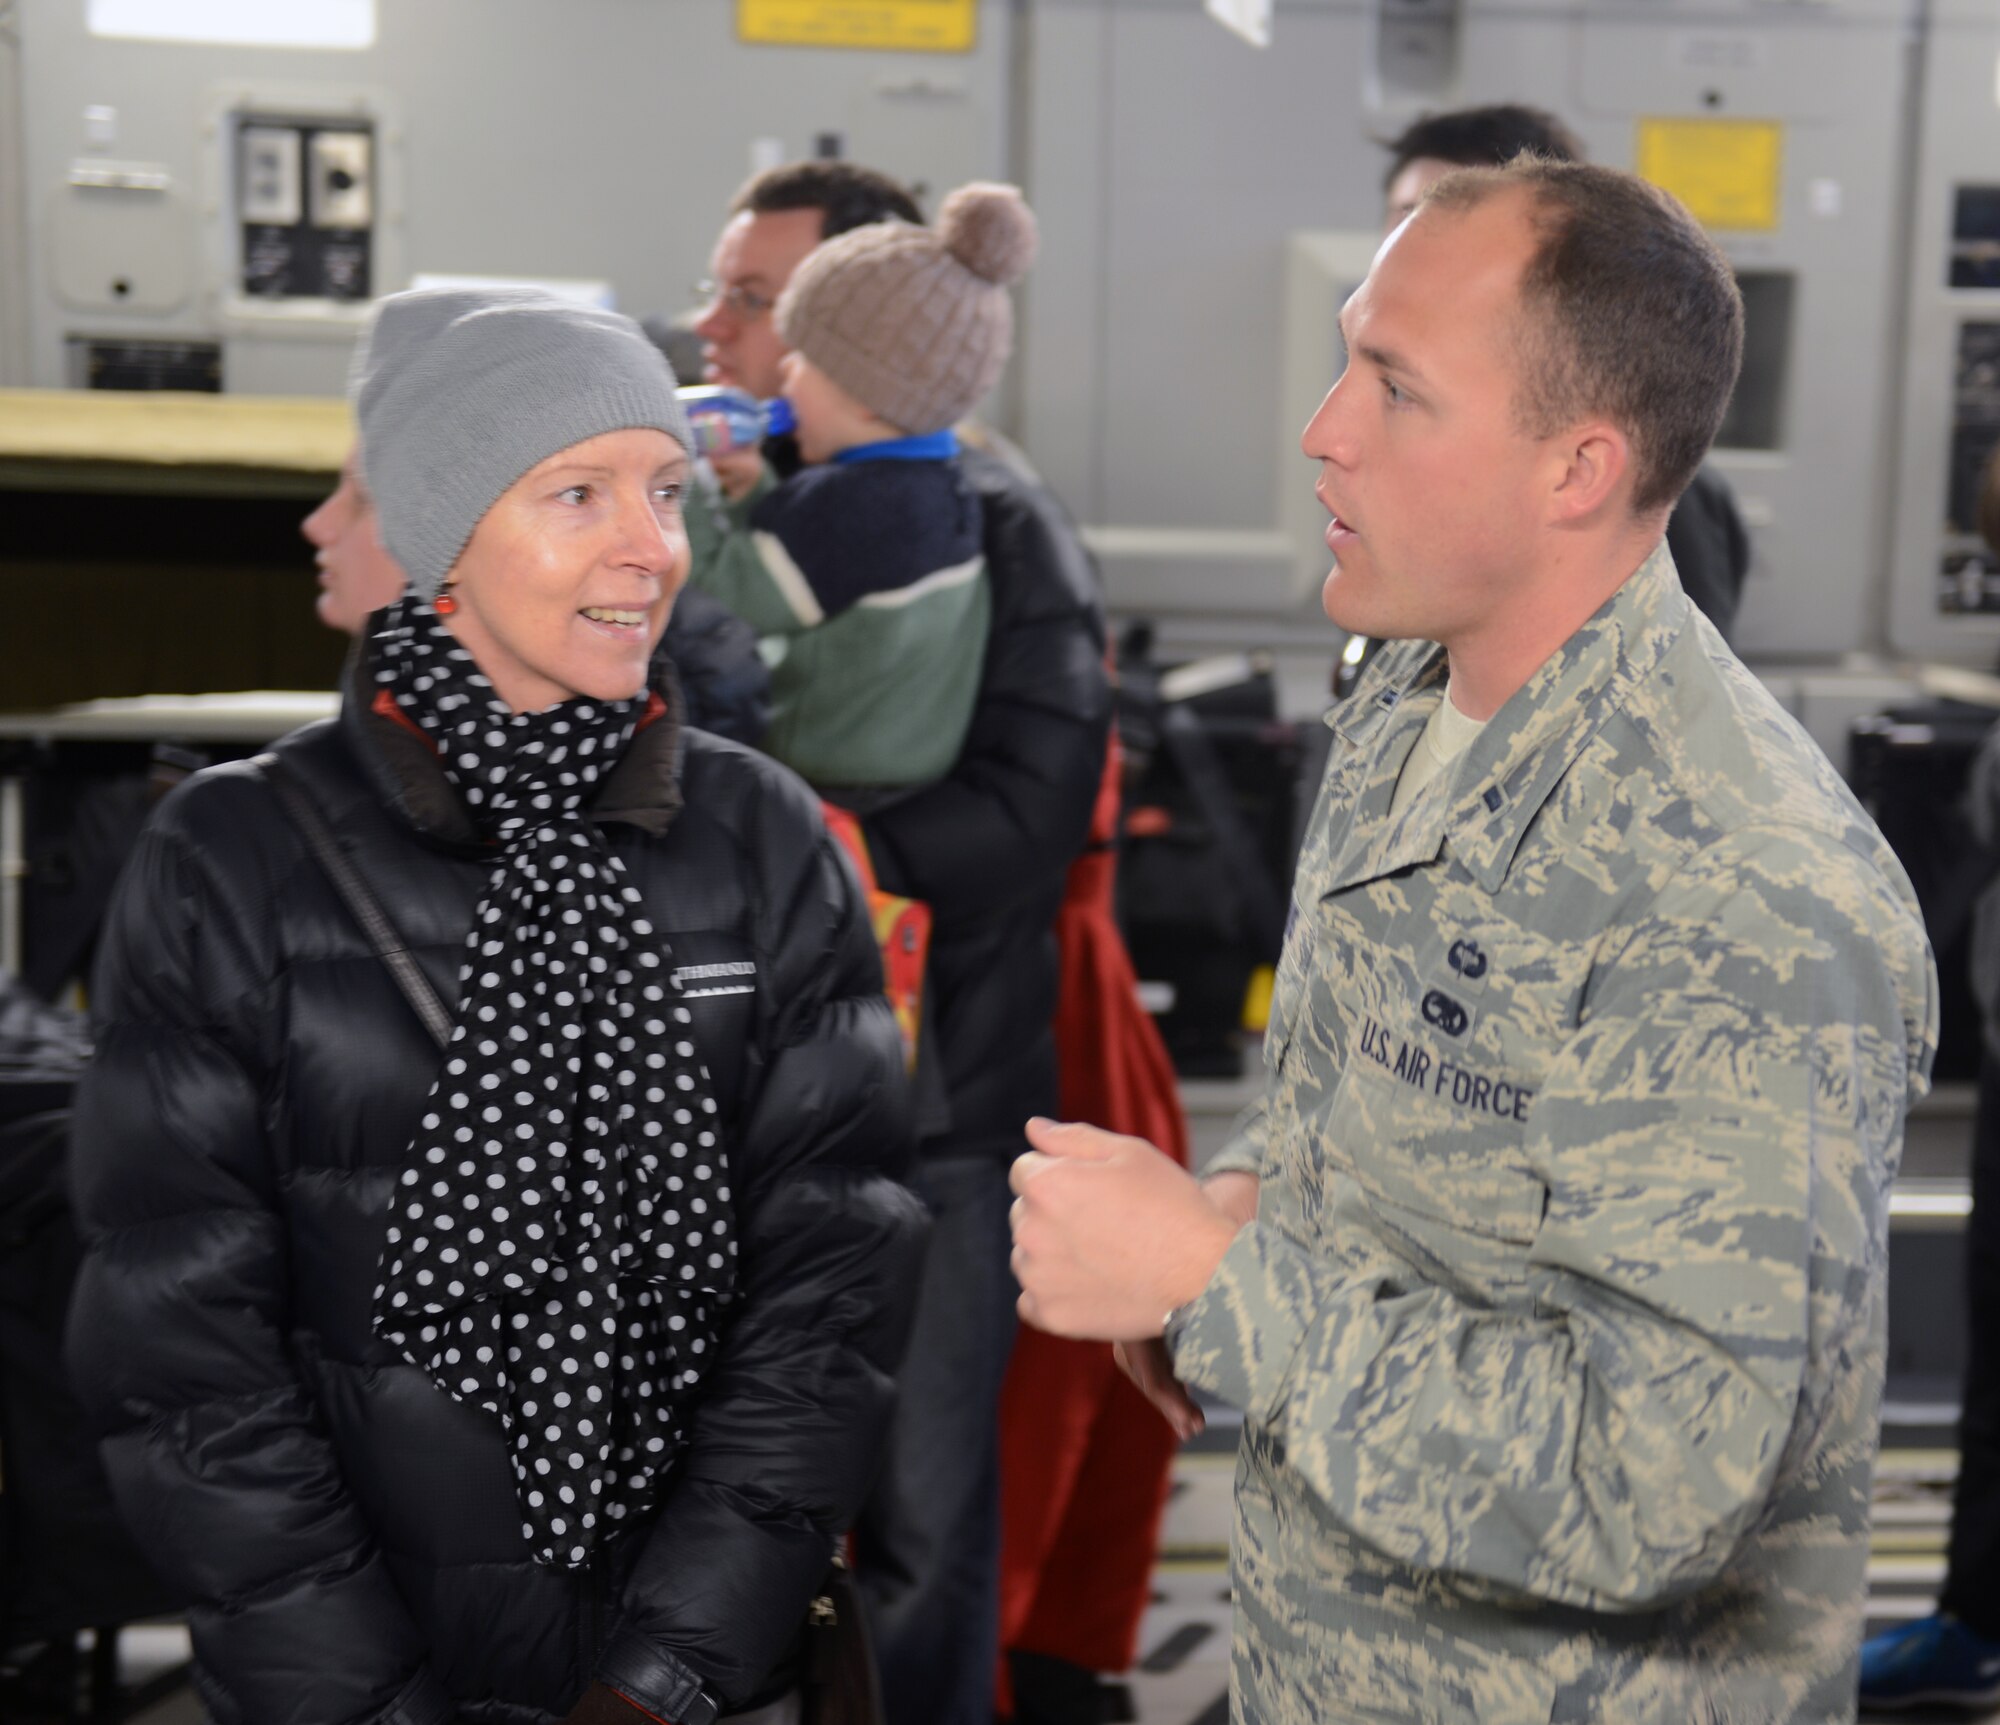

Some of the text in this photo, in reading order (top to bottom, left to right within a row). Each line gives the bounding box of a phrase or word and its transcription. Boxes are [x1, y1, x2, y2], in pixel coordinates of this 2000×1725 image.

[1361, 1017, 1533, 1123] U.S. AIR FORCE
